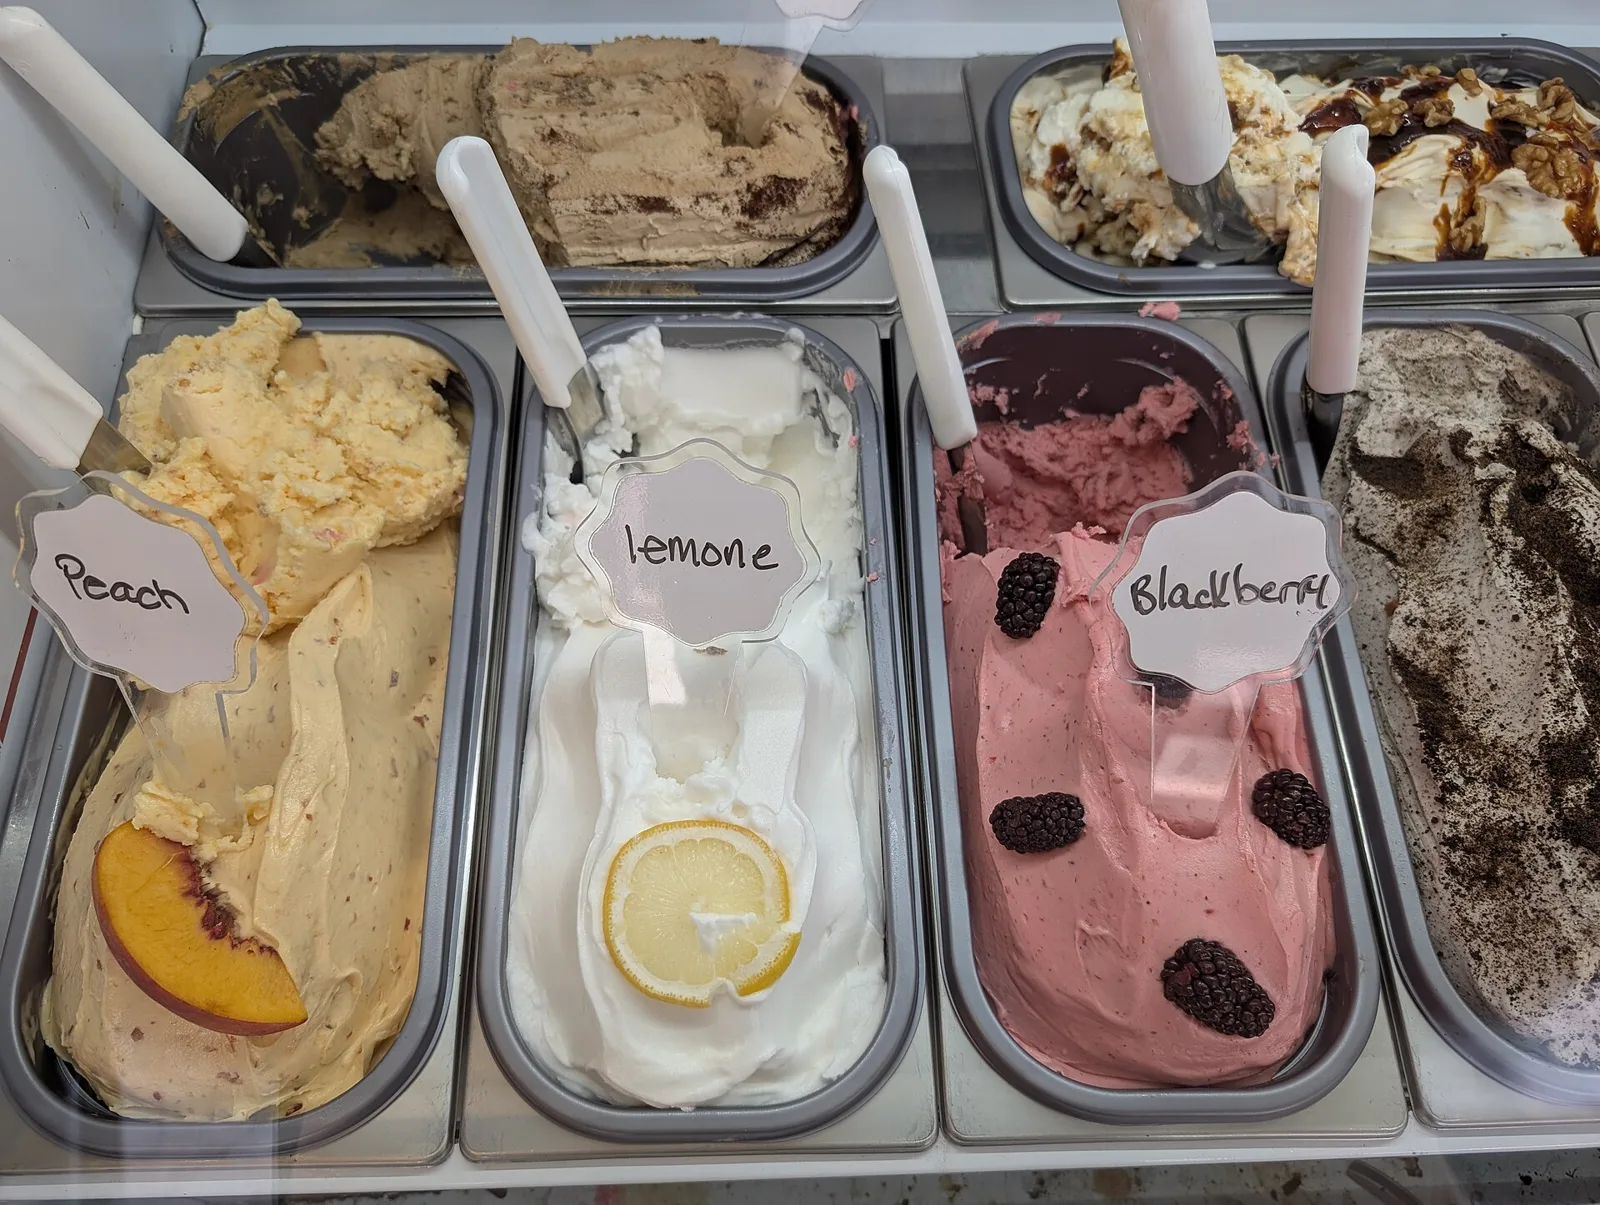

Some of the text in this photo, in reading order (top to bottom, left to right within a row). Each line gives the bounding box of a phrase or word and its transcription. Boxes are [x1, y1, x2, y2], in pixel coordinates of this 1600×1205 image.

[625, 524, 779, 570] lemone
[54, 553, 190, 614] Peach
[1130, 563, 1330, 615] Blackberry
